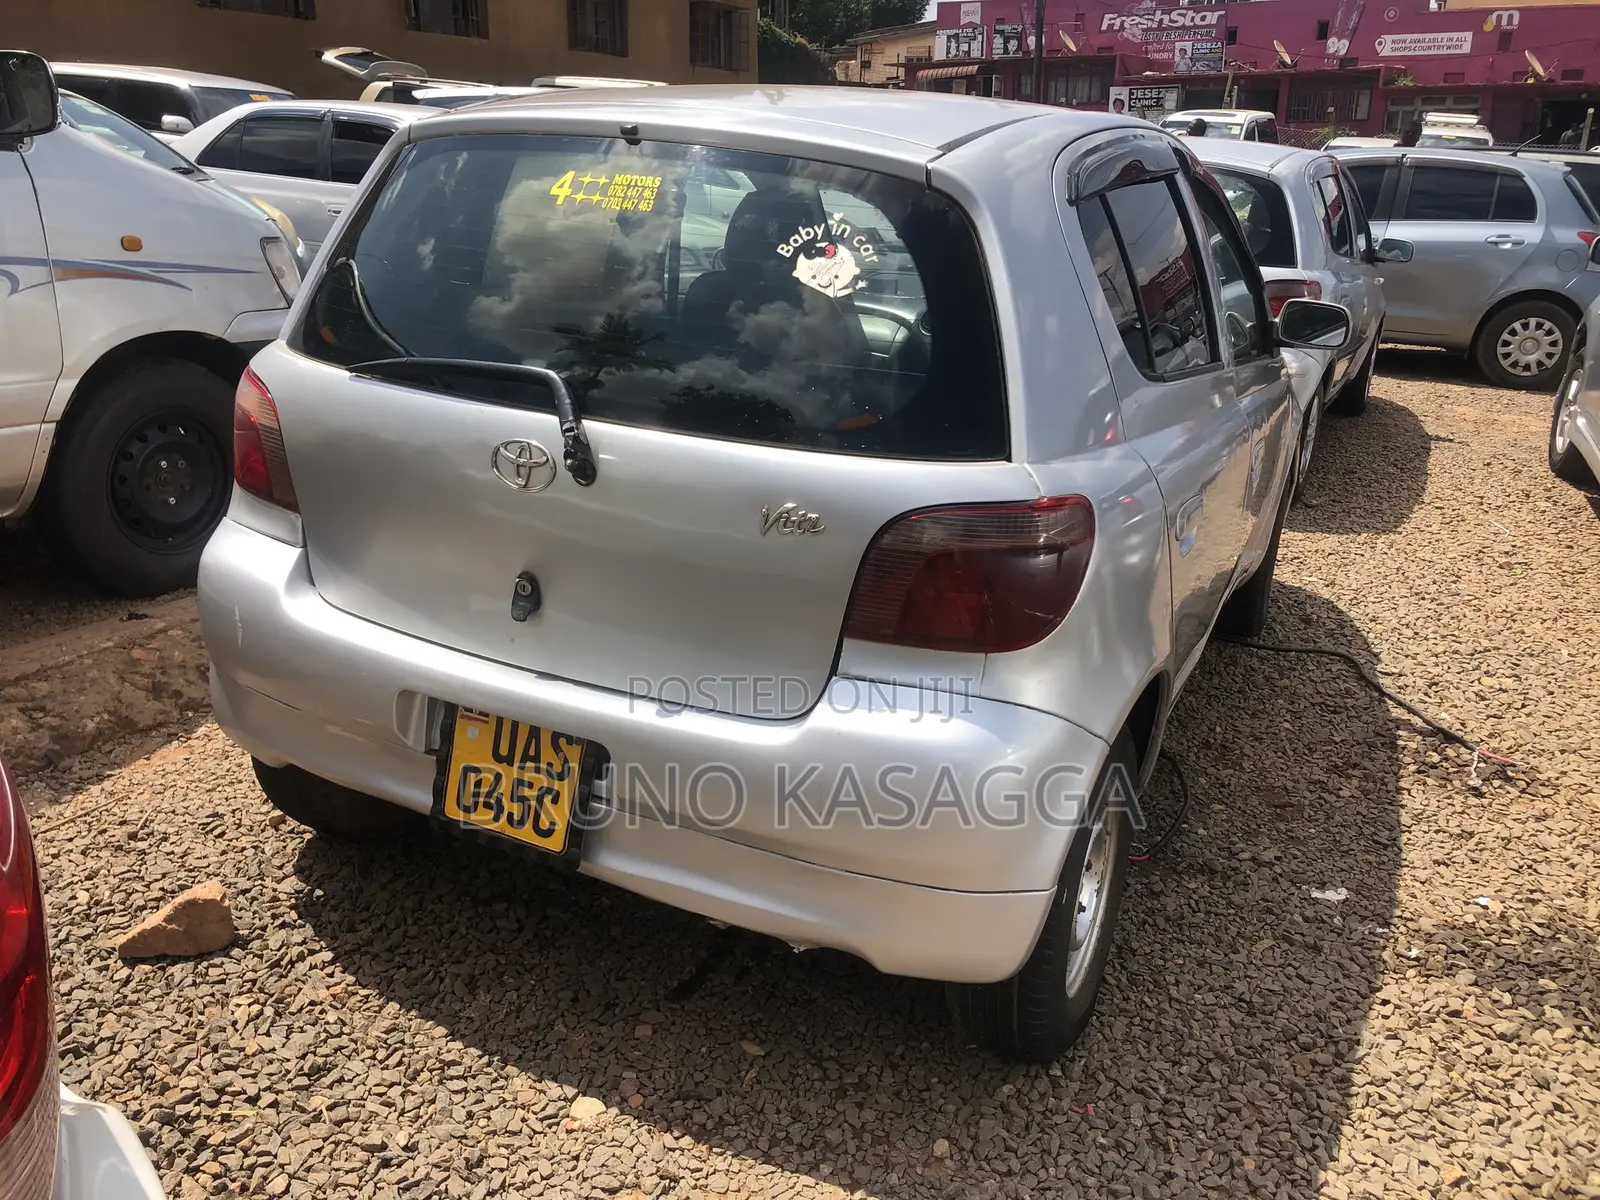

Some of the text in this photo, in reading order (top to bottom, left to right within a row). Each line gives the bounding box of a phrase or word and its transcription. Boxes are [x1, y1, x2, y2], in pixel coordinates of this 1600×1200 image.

[1100, 9, 1226, 31] FreshStar
[1161, 30, 1183, 40] FRESH
[1193, 41, 1222, 49] JESEZA
[1413, 43, 1464, 52] COUNTRYWIDE
[1130, 88, 1166, 99] JESEZ
[612, 173, 662, 188] MOTORS
[607, 185, 658, 200] 0782 447 463
[601, 197, 654, 212] 0703 447 463
[776, 214, 879, 262] Baby in car
[759, 502, 825, 537] Vitz
[491, 714, 575, 782] UAS
[456, 763, 561, 839] 045C
